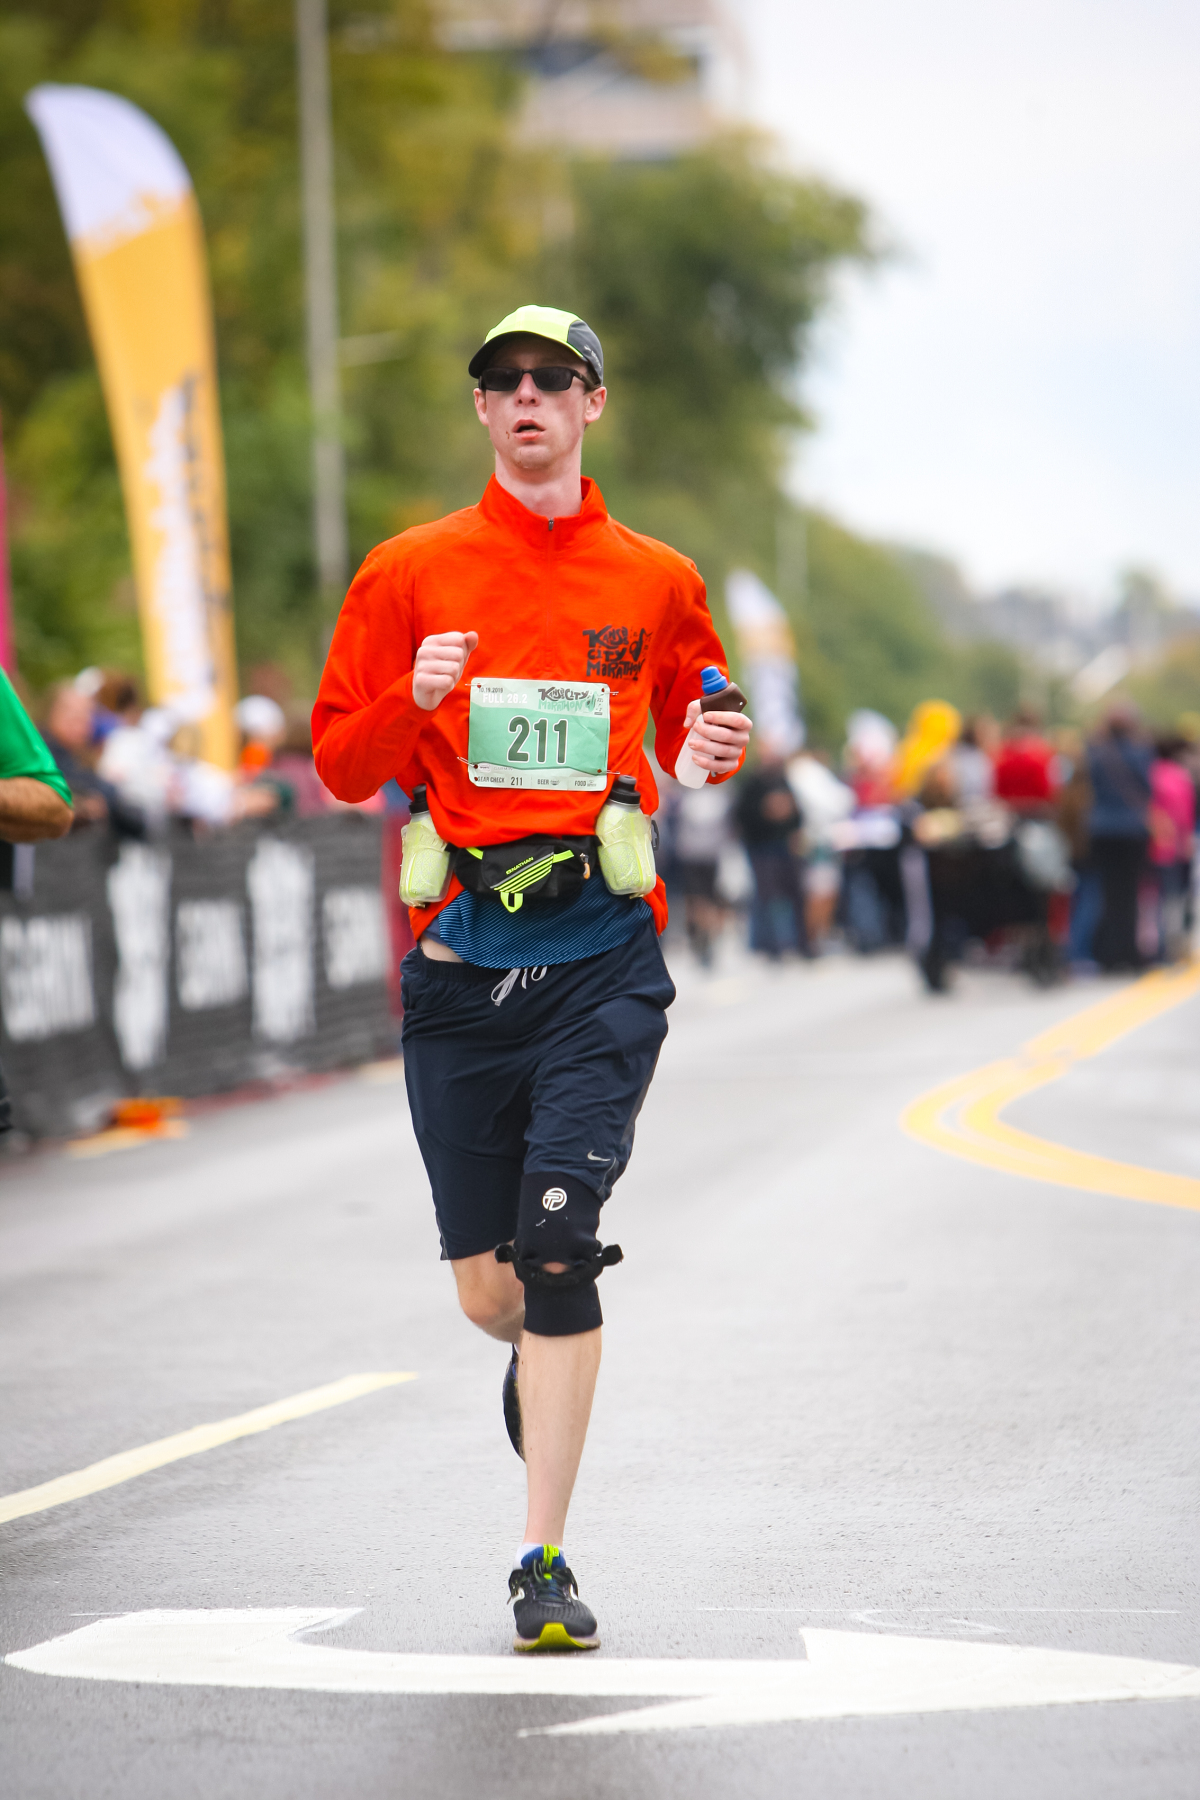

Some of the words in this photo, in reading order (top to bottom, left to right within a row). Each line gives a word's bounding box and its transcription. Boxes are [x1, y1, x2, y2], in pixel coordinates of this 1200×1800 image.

[587, 647, 627, 662] CITY
[482, 693, 505, 704] FULL
[507, 693, 528, 704] 26.2
[564, 688, 589, 701] CITY
[507, 715, 569, 765] 211
[510, 776, 523, 786] 211
[510, 856, 534, 871] NATHAN
